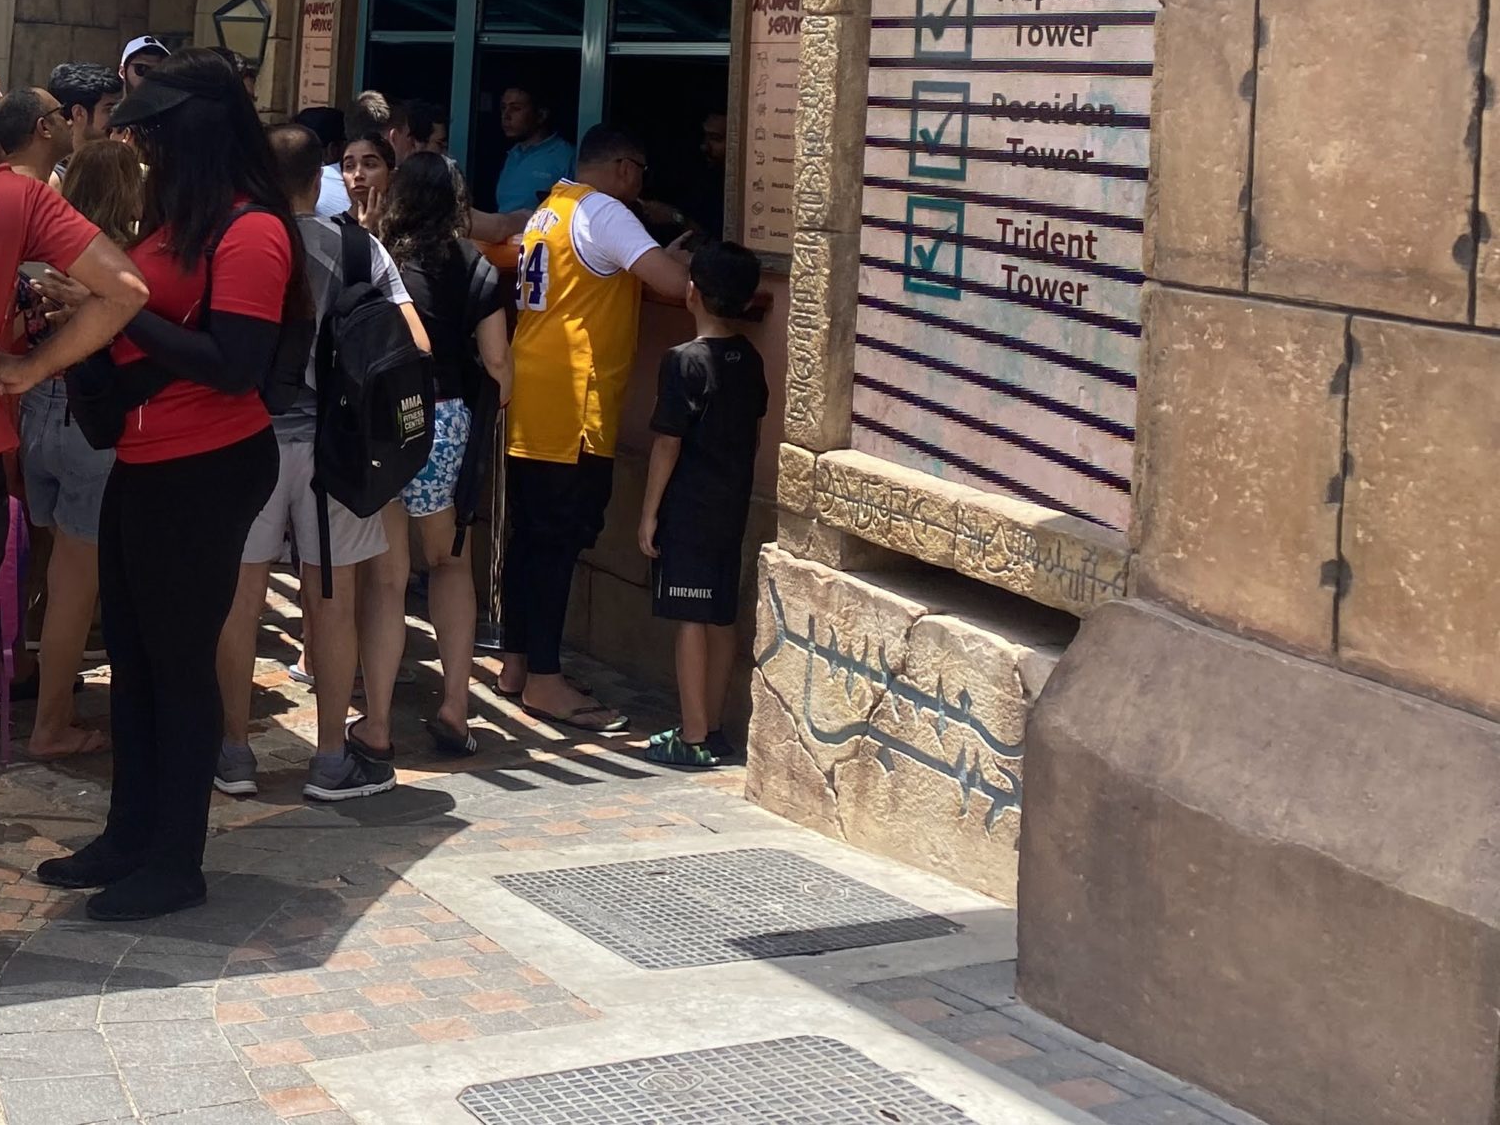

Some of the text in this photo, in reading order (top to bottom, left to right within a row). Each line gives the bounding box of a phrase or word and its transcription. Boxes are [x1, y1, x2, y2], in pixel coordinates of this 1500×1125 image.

[1012, 22, 1100, 48] Tower
[990, 92, 1117, 128] Poseidon
[1006, 137, 1095, 171] Tower
[996, 218, 1099, 260] Trident
[1001, 264, 1090, 307] Tower
[401, 394, 423, 412] MMA
[403, 409, 424, 424] FITNESS
[404, 417, 425, 431] CENTER
[669, 586, 713, 599] AIRMAX
